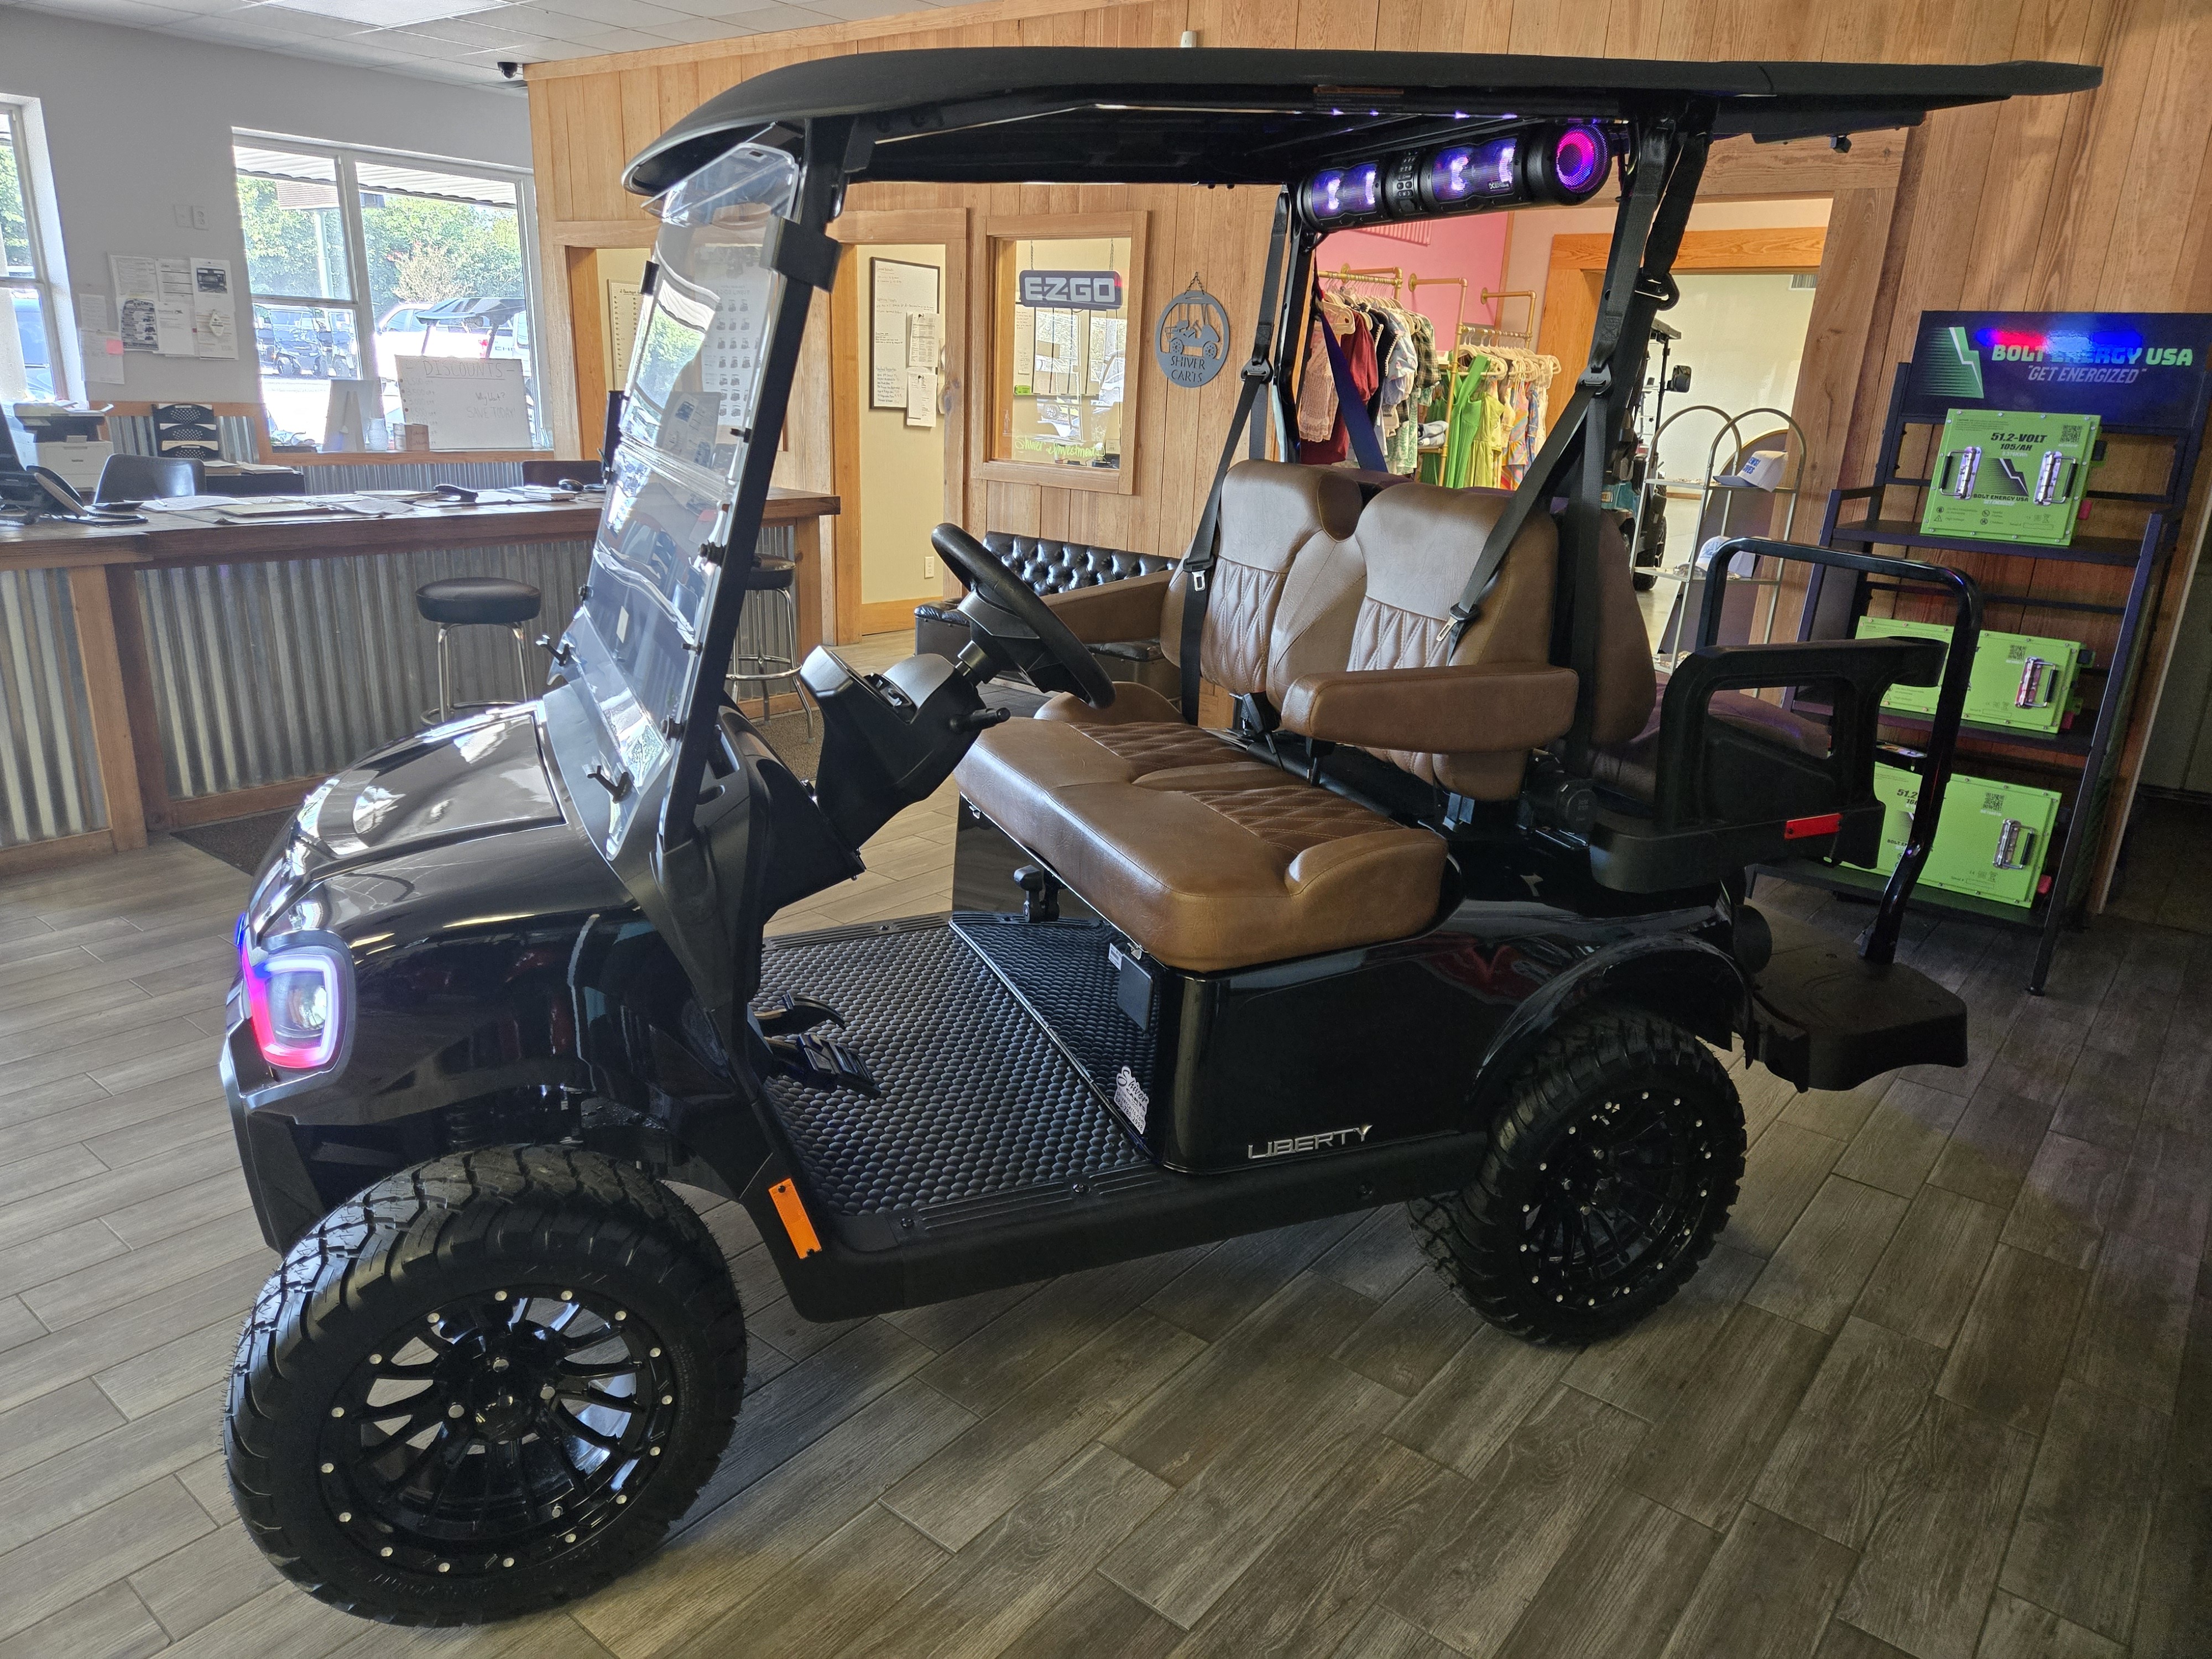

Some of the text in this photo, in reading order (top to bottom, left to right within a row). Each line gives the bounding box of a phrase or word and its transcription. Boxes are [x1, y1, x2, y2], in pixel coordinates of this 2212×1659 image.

[1024, 277, 1115, 302] EZGO
[1171, 355, 1205, 370] SHIVER
[1992, 344, 2044, 362] BOLT
[2145, 348, 2193, 366] USA
[423, 360, 503, 378] DISCOUNTS
[1171, 369, 1202, 383] CARTS
[1991, 432, 2048, 443] 51.2-VOLT
[2000, 443, 2033, 451] 105/AH
[1118, 1069, 1148, 1103] Shiver
[1248, 1125, 1373, 1160] LIBERTY
